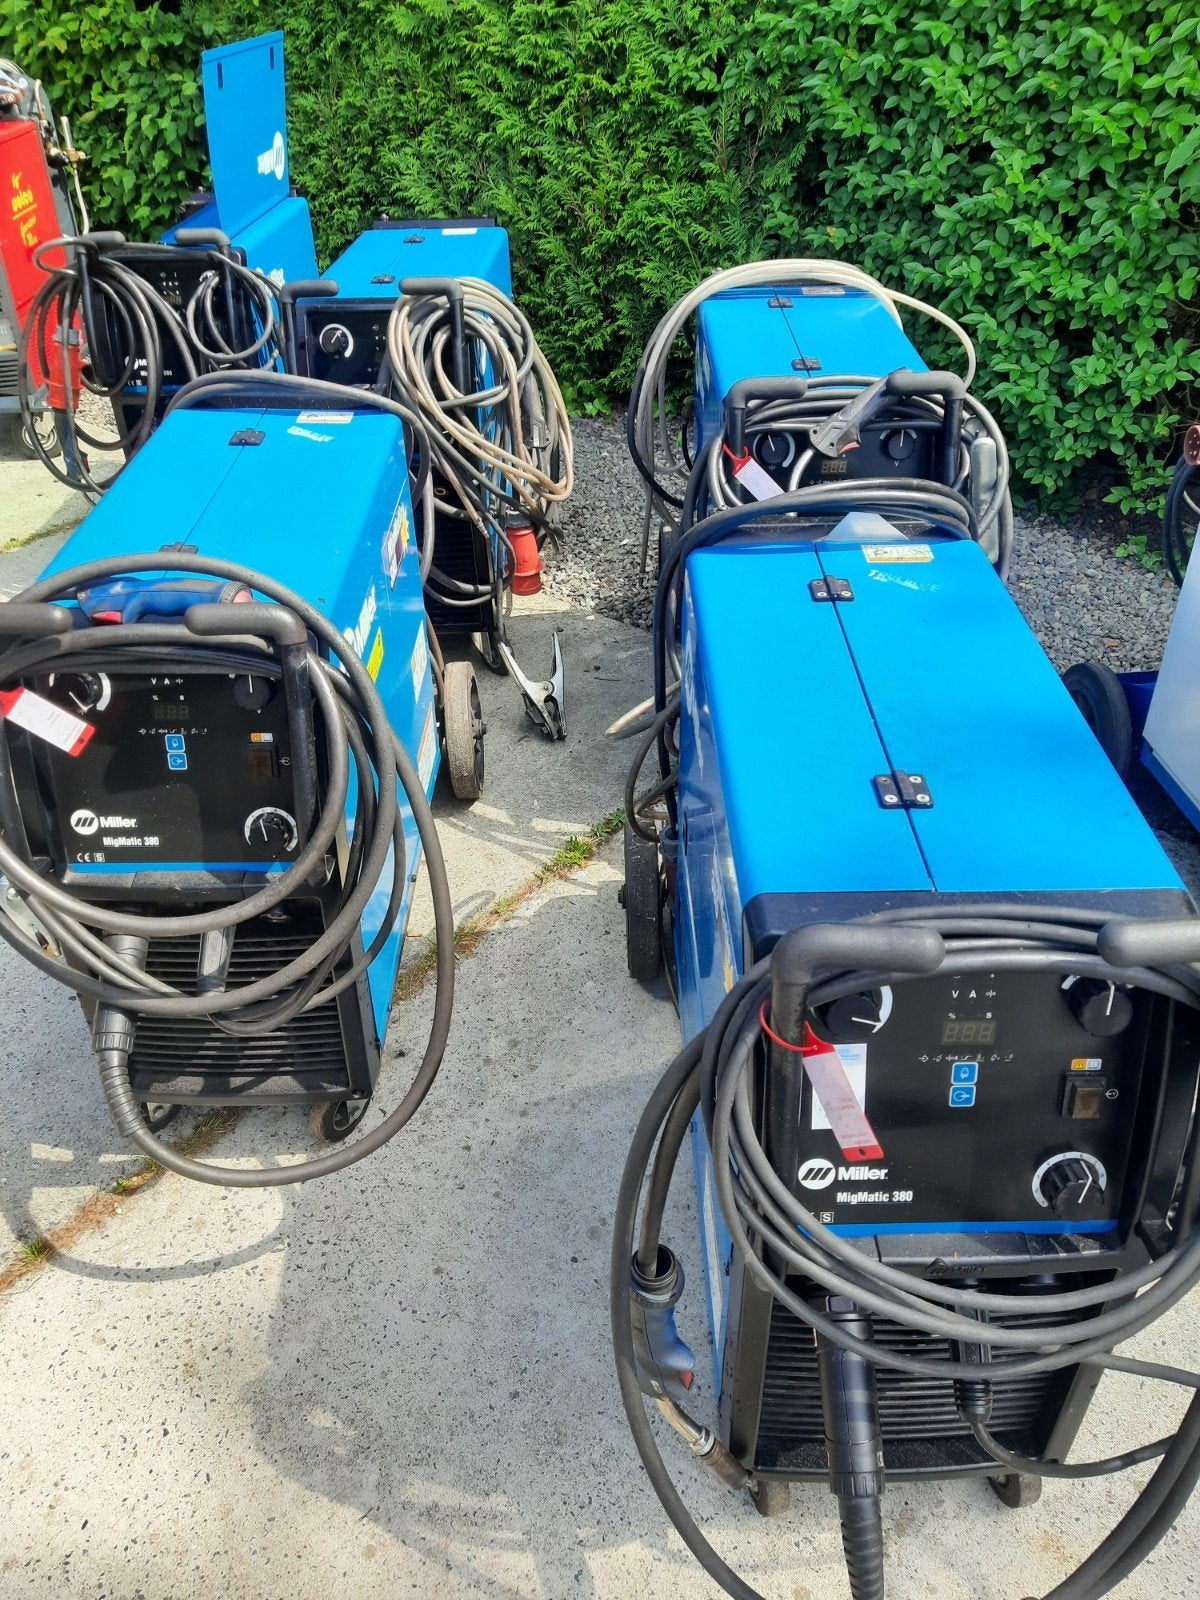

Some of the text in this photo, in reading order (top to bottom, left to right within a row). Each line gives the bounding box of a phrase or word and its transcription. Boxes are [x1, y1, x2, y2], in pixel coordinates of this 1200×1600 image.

[100, 816, 138, 828] Miller
[103, 836, 160, 848] MigMatic 380
[951, 990, 977, 999] V A
[837, 1166, 889, 1181] Miller
[836, 1190, 914, 1205] MigMatic 380
